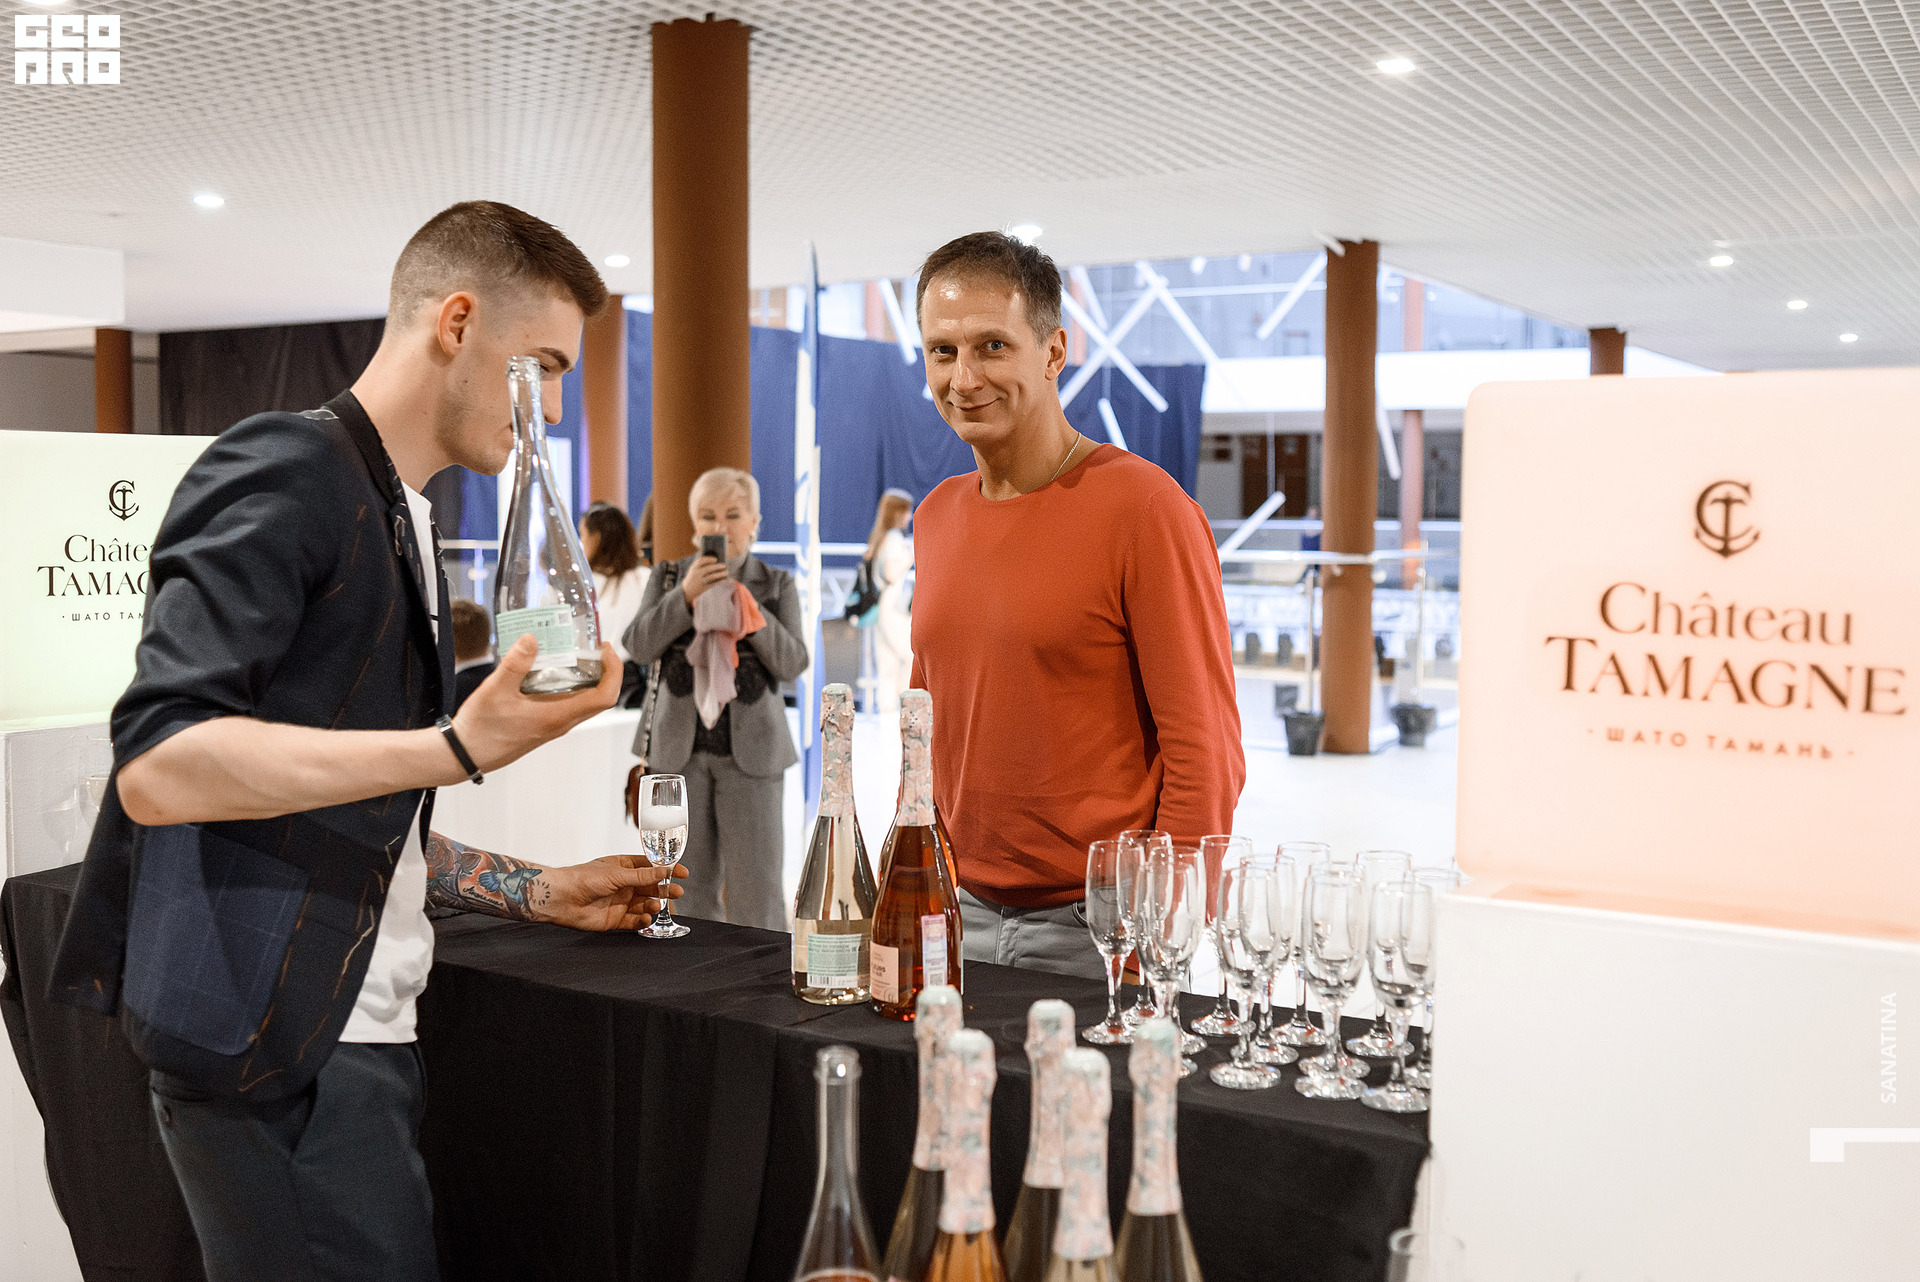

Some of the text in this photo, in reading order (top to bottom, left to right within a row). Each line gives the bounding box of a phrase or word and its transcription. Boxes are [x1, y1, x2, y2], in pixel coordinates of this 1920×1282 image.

[64, 534, 153, 563] Châte
[71, 612, 111, 622] ШАТО
[1598, 581, 1854, 647] Château
[1544, 634, 1908, 717] TAMAGNE
[1606, 728, 1833, 760] ШАТО ТАМАНЬ
